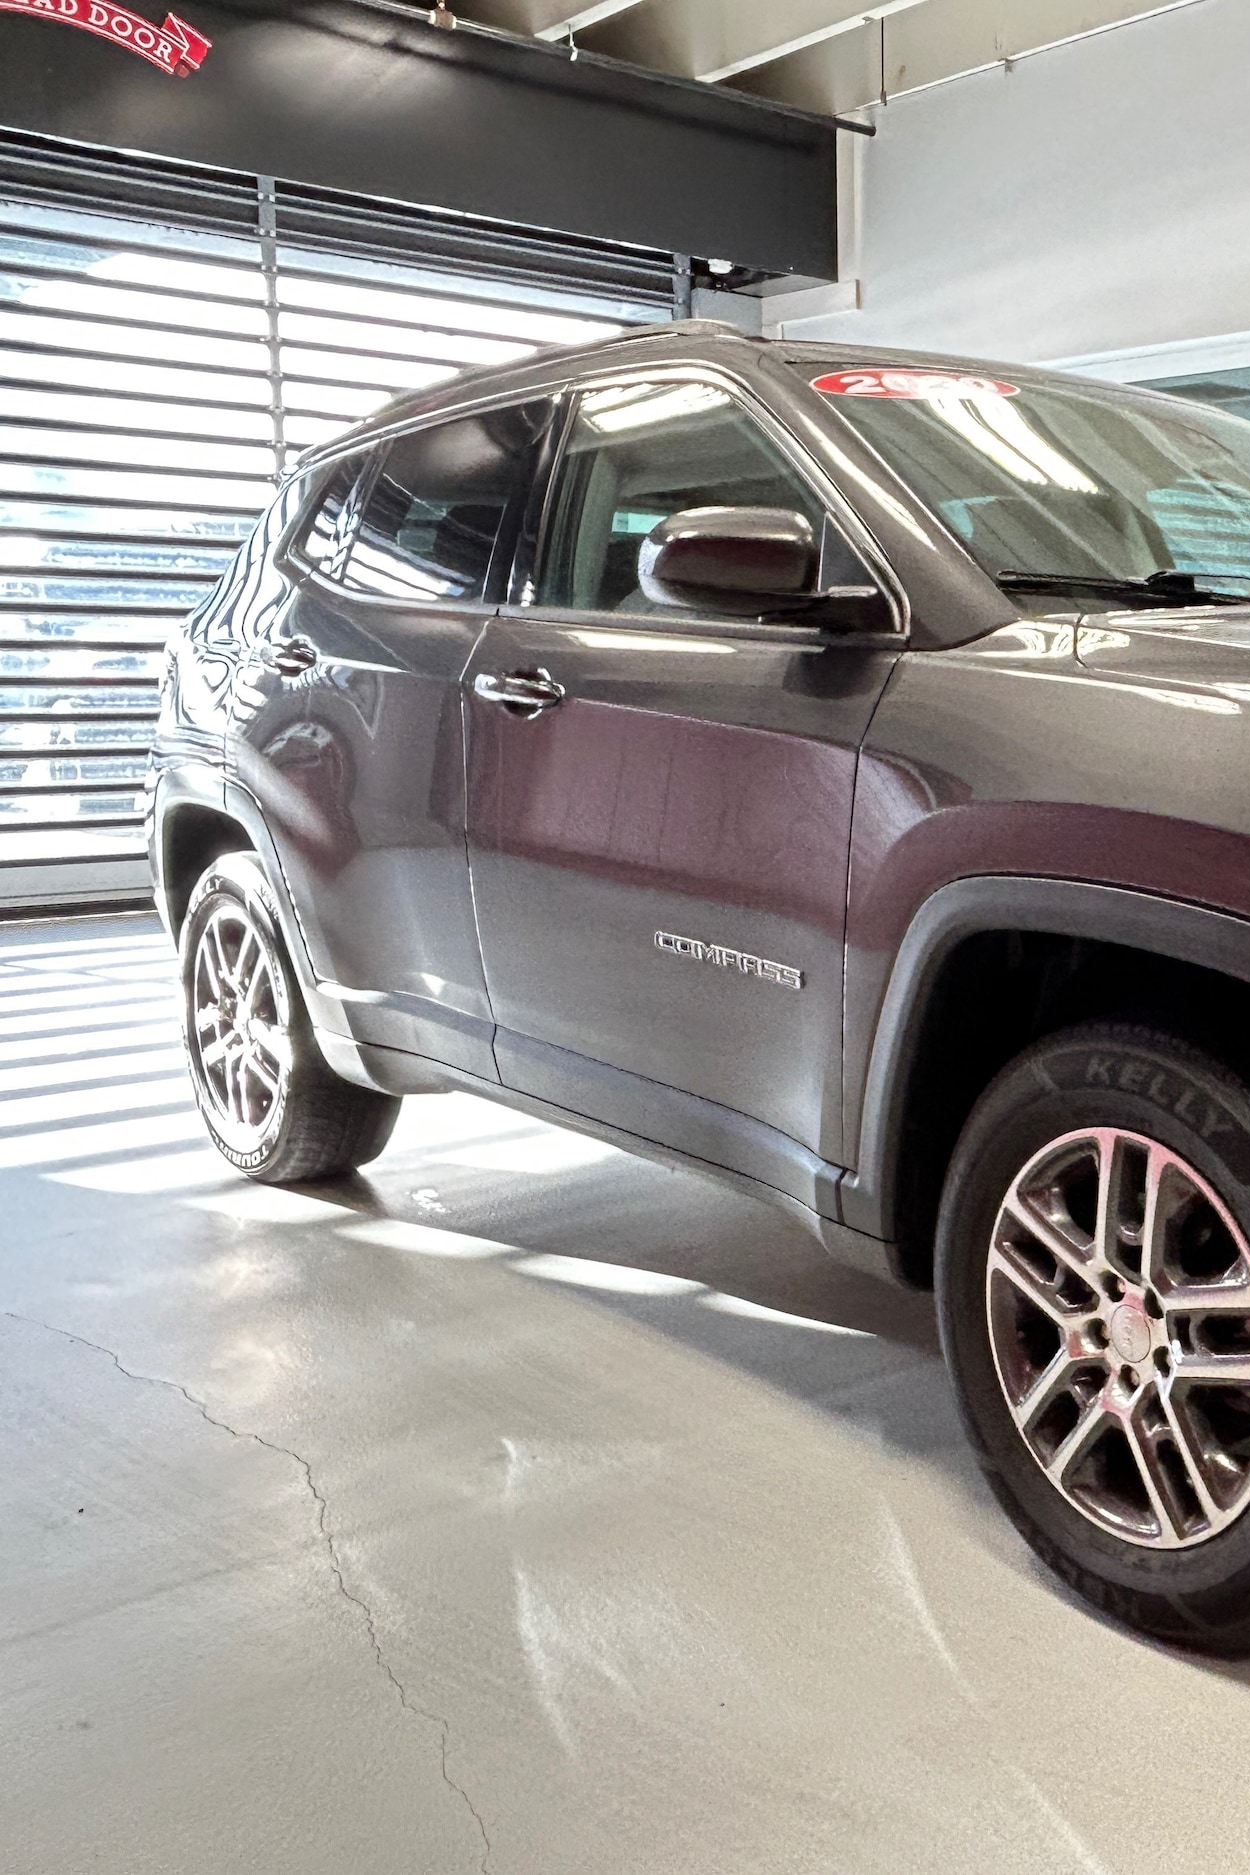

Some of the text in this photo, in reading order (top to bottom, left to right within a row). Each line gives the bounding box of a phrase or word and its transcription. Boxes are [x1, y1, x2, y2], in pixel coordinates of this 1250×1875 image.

[88, 3, 174, 63] DOOR
[655, 931, 803, 989] COMPASS
[1086, 1056, 1235, 1138] KELLY
